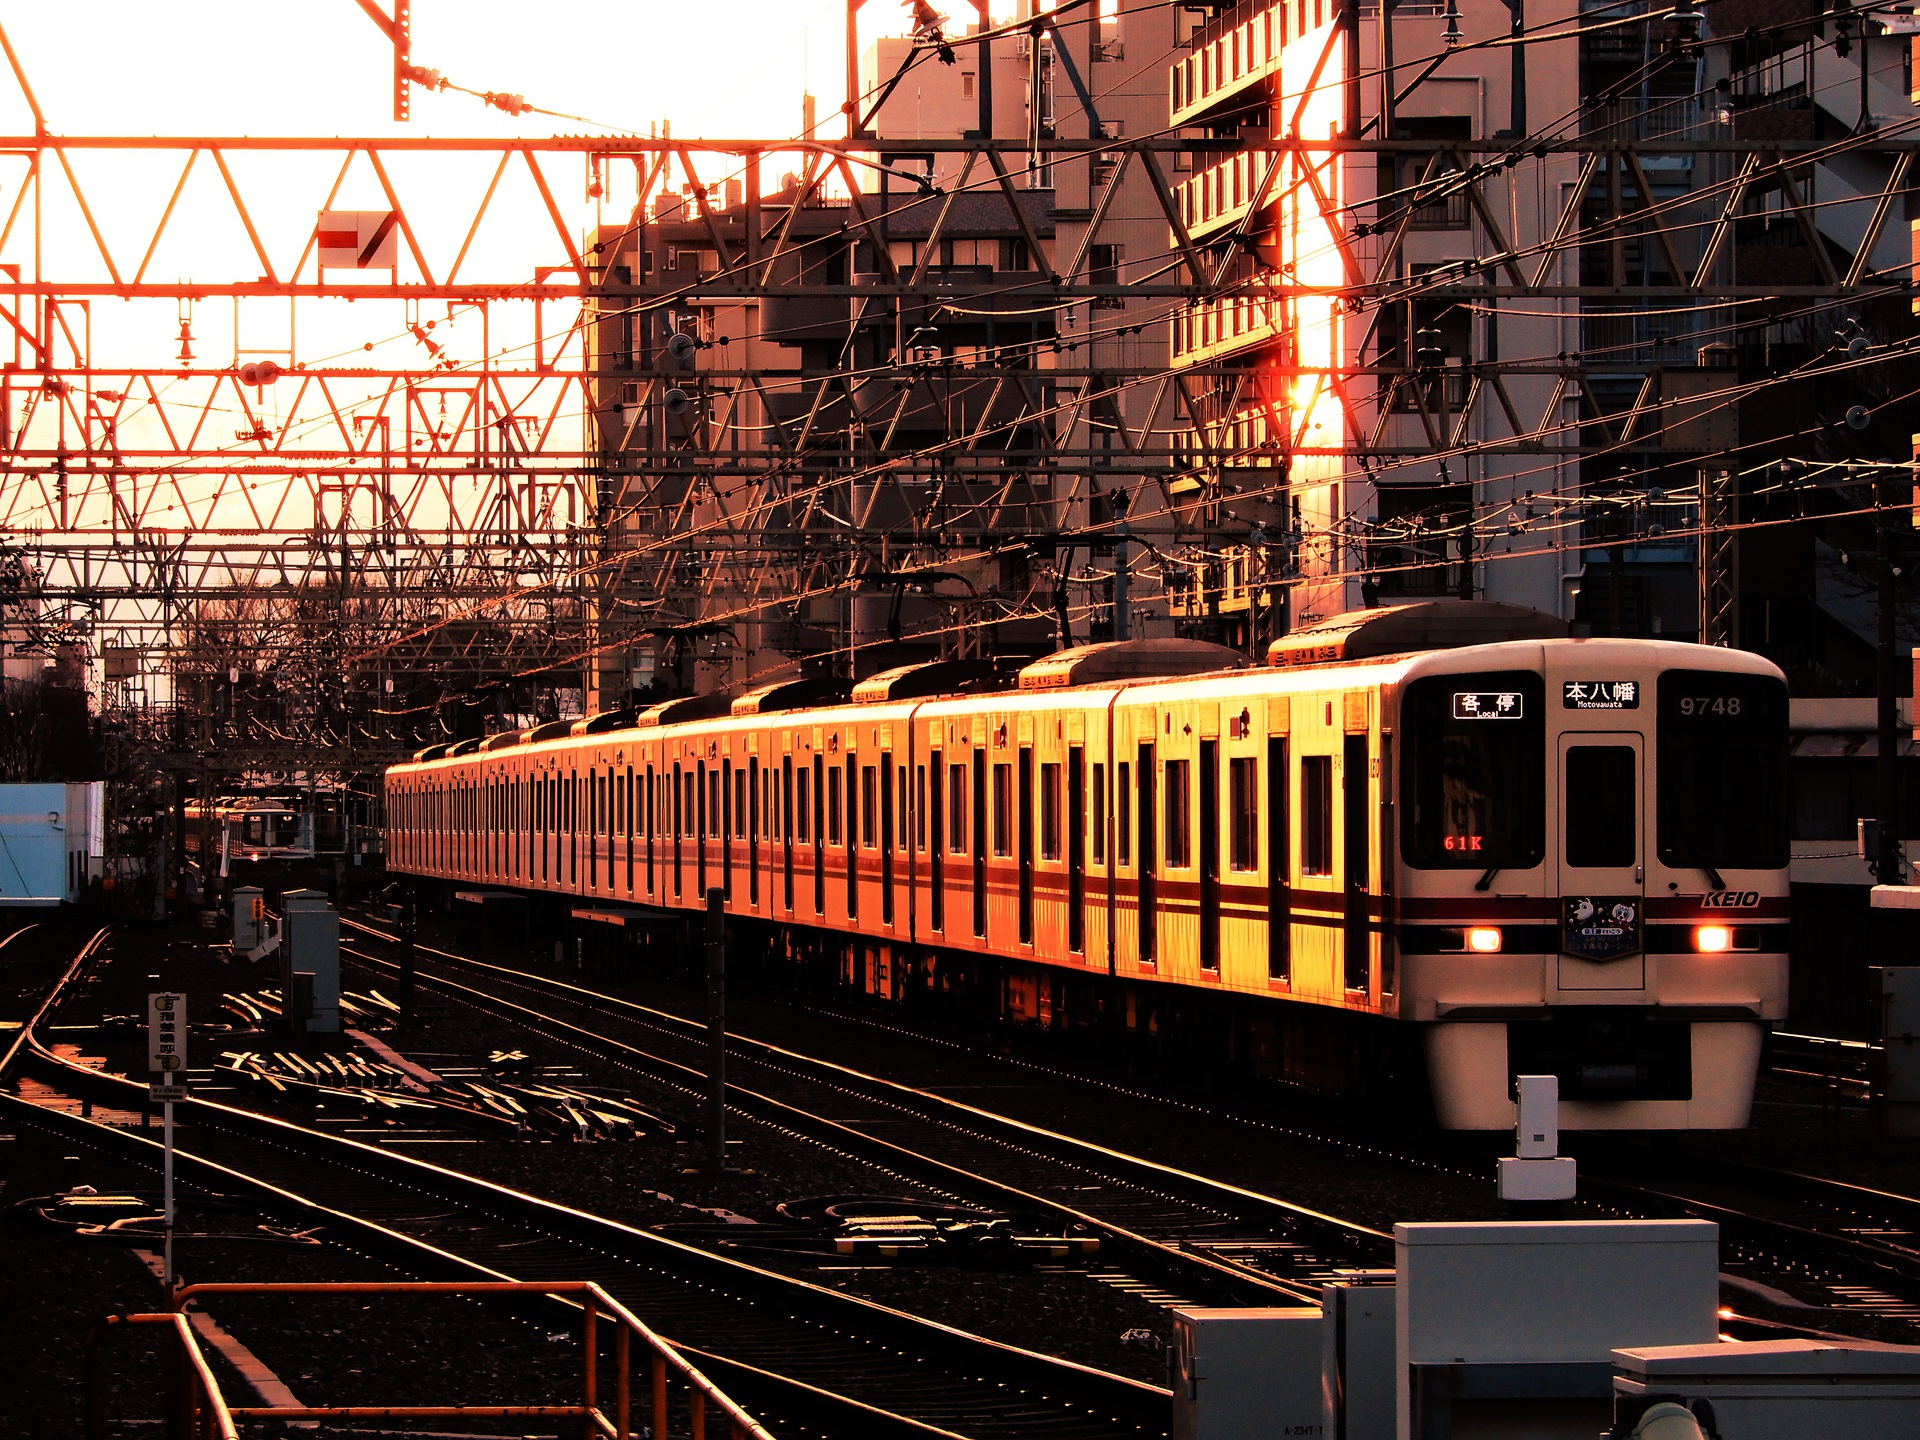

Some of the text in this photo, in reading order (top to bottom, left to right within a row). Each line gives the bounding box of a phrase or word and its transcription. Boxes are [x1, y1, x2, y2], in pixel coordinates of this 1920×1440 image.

[1566, 682, 1635, 701] 本八幡
[1681, 697, 1741, 715] 9748
[1445, 836, 1482, 850] 61K
[1704, 891, 1760, 906] KEIO
